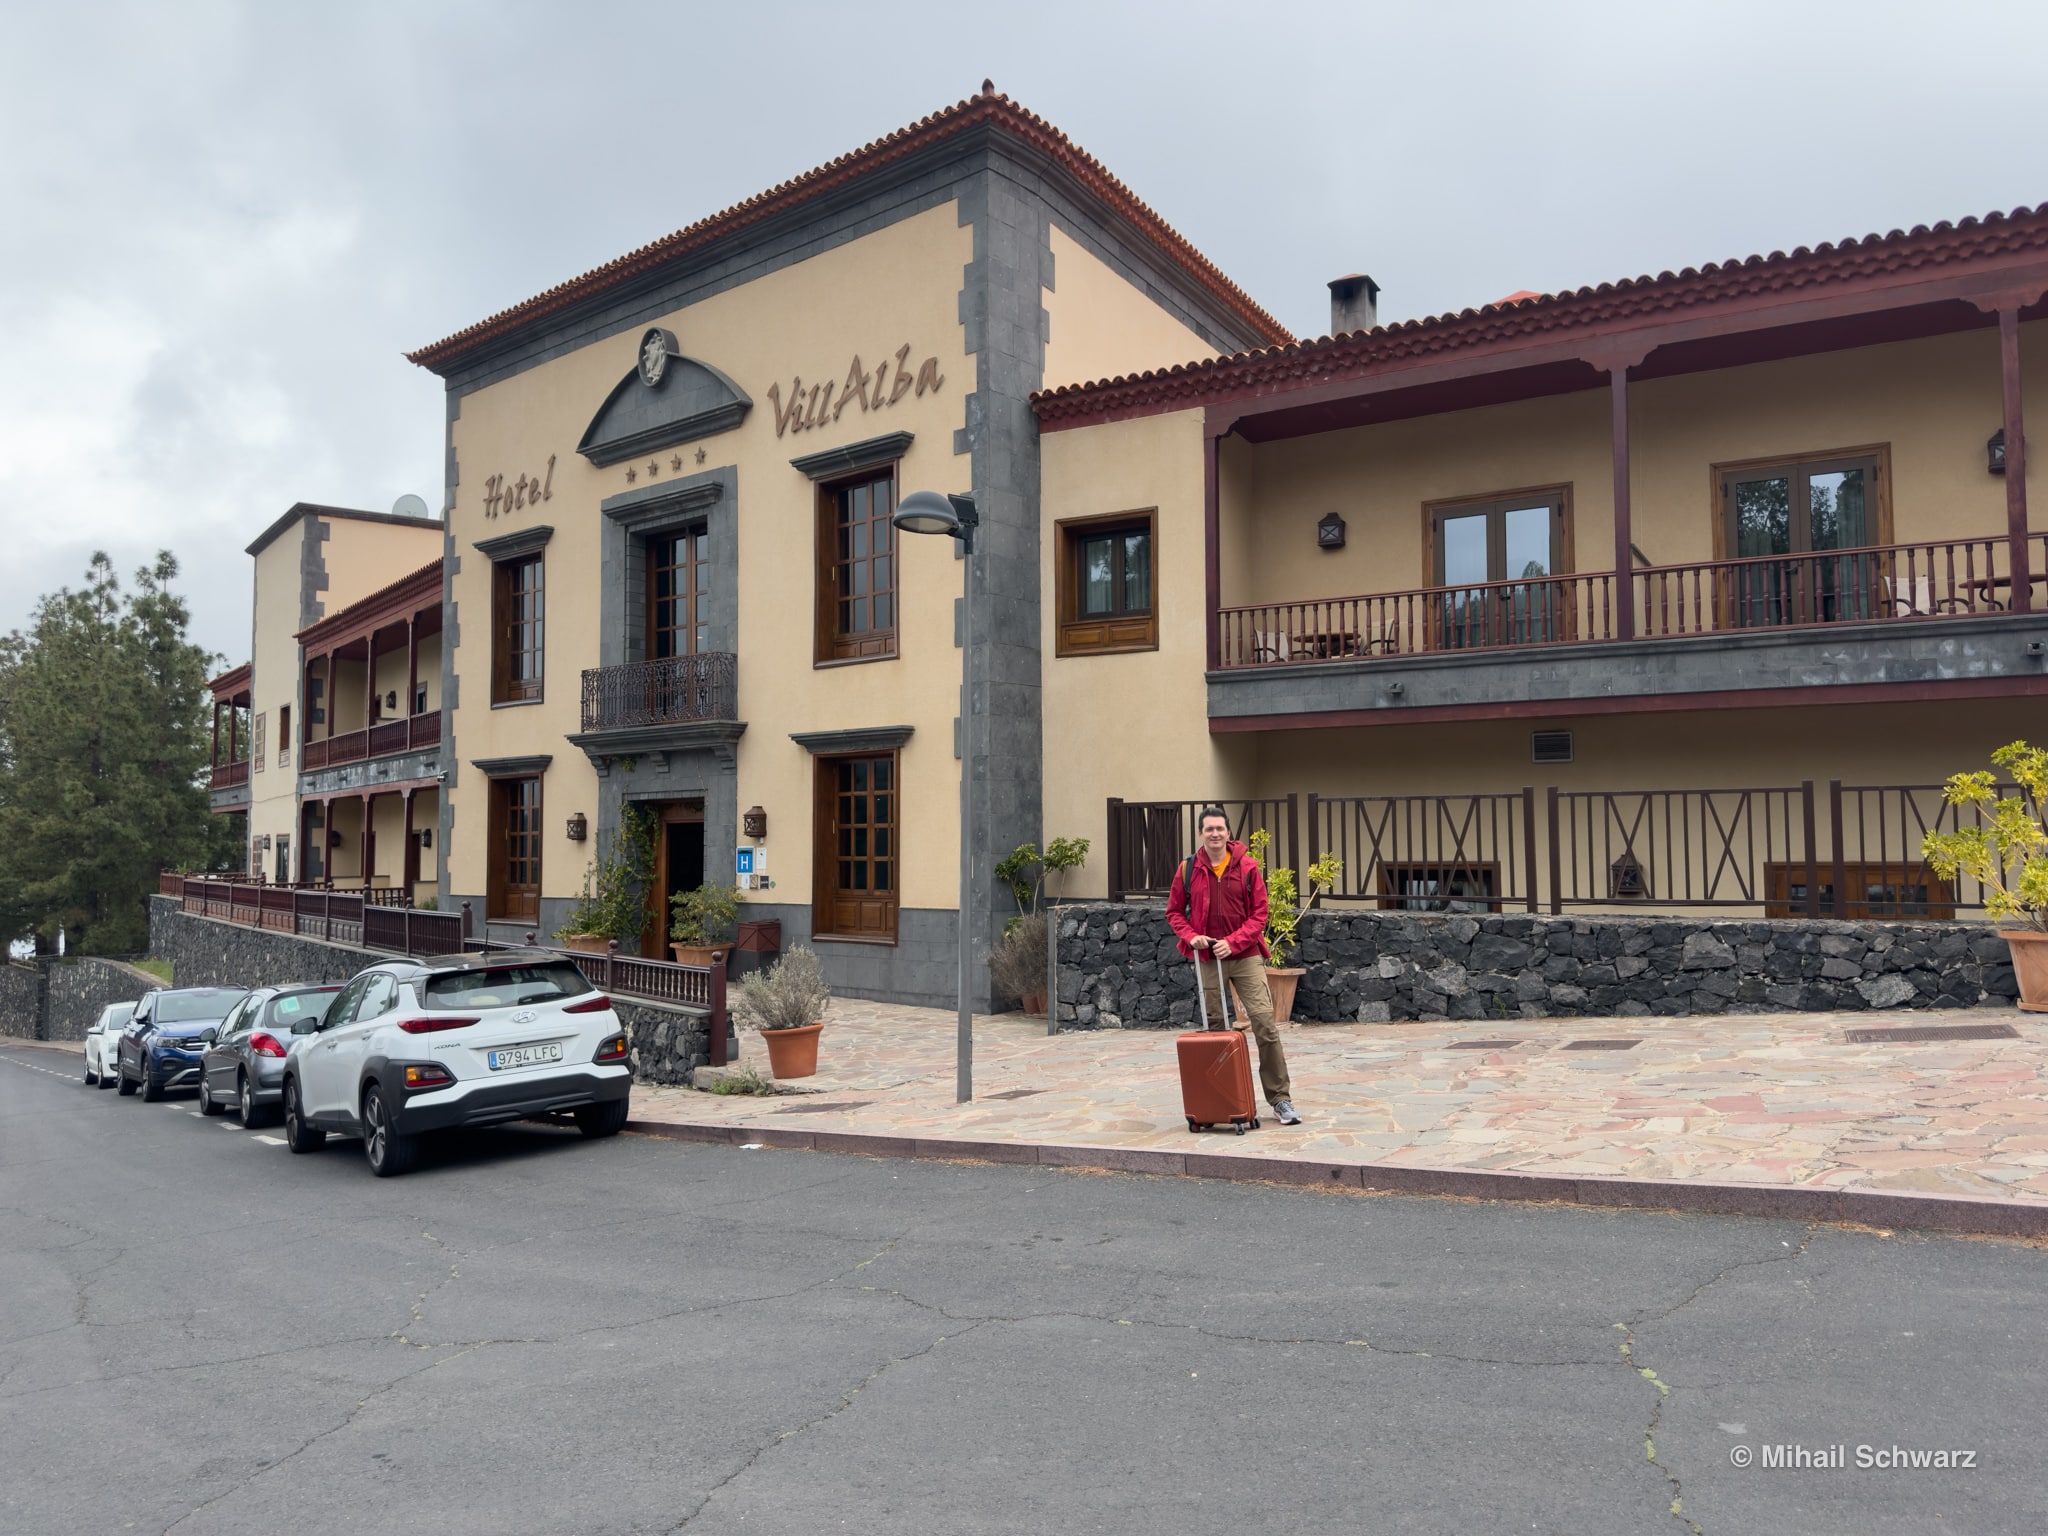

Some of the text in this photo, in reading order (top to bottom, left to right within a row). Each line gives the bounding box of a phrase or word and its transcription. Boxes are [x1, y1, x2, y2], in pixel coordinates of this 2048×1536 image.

[483, 342, 945, 520] Hotel VillAlba
[740, 855, 749, 870] H
[498, 1046, 558, 1065] 9794 LFC
